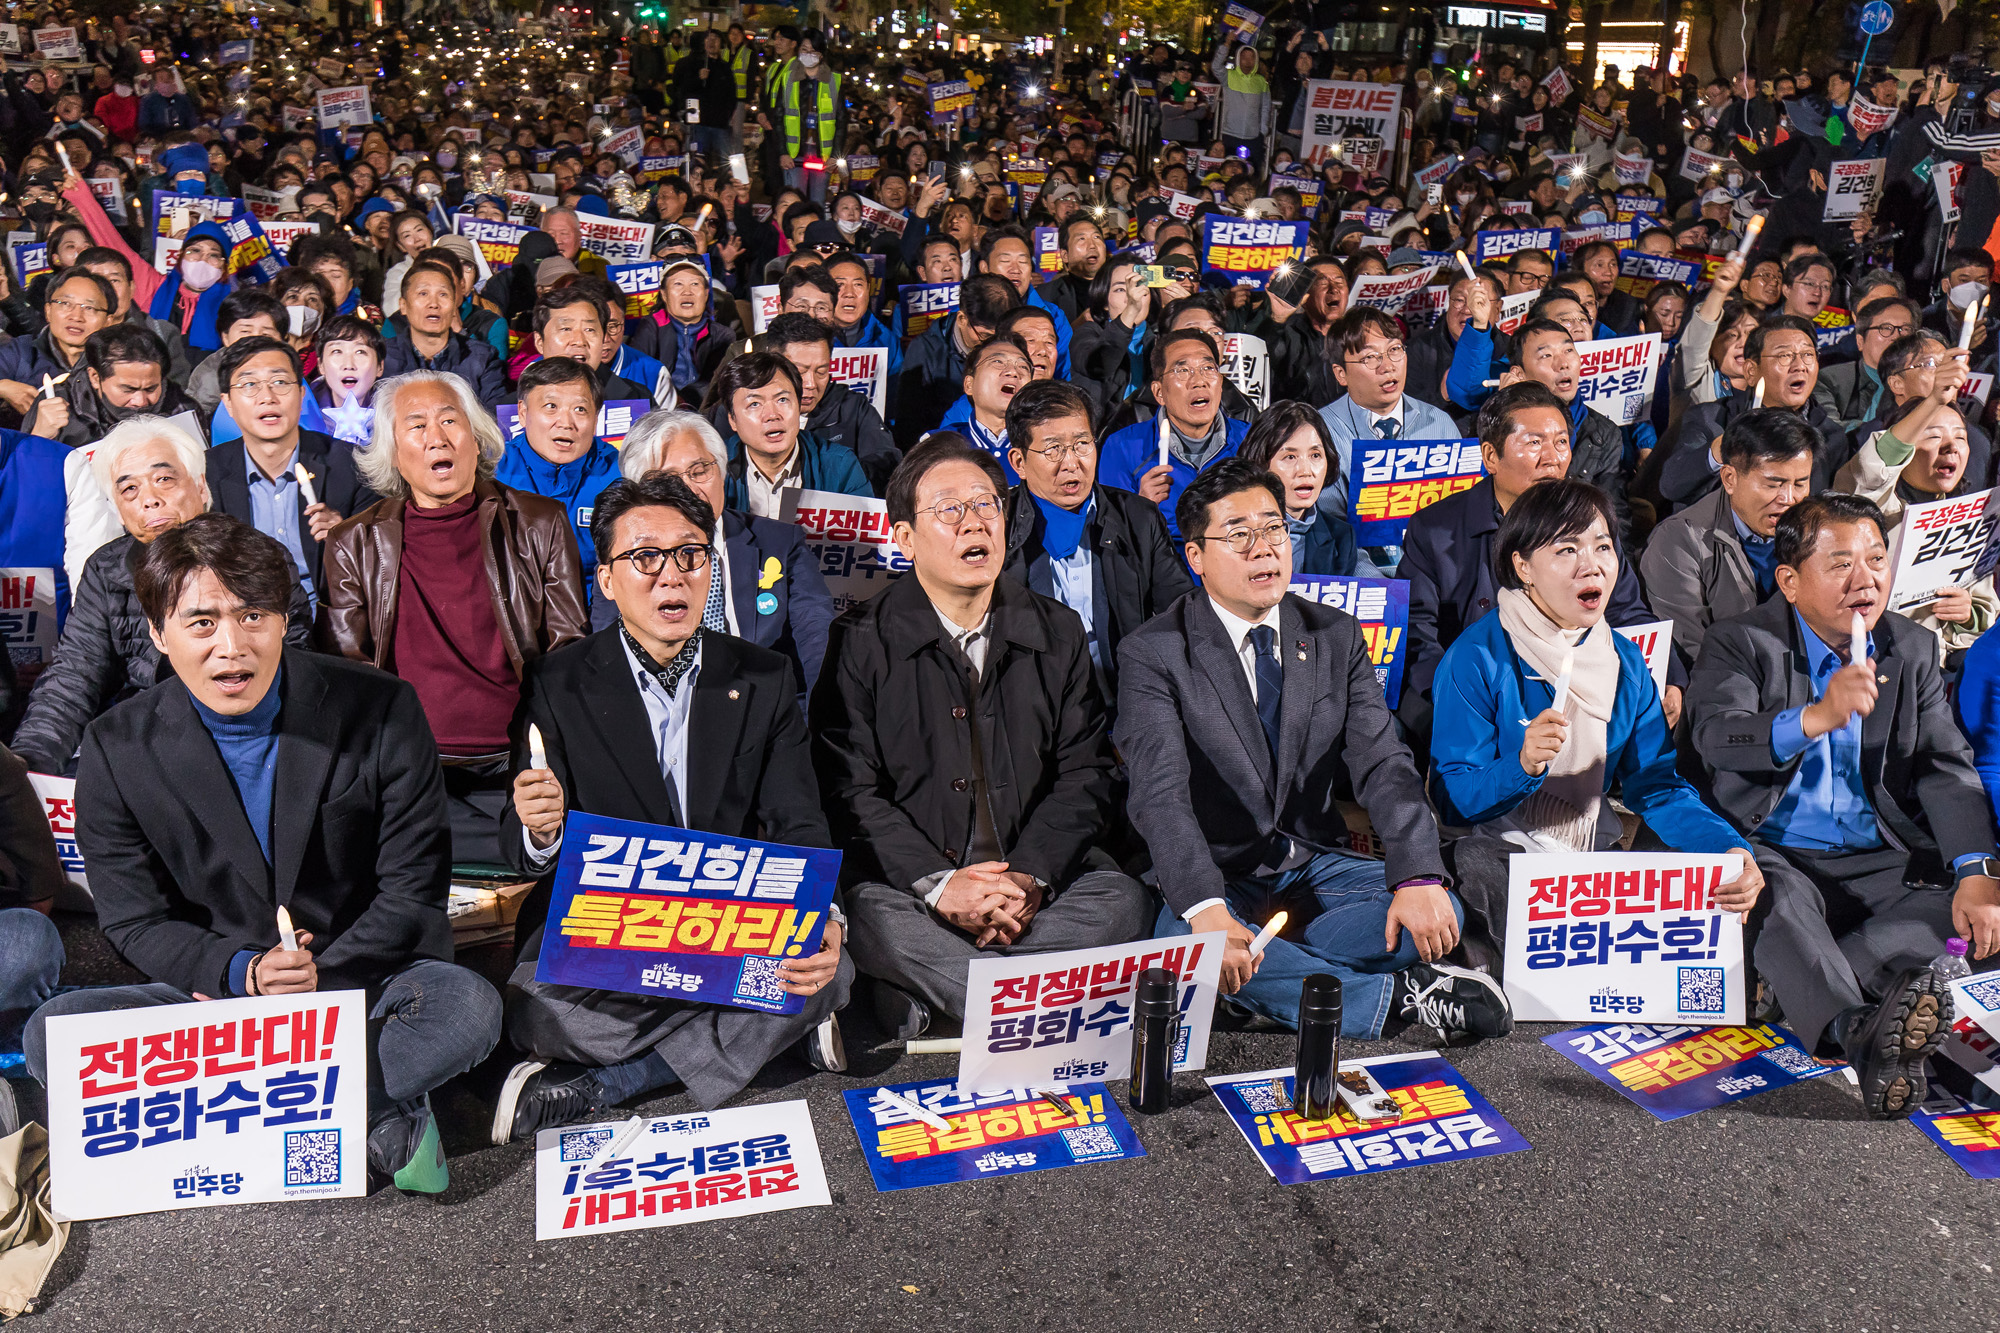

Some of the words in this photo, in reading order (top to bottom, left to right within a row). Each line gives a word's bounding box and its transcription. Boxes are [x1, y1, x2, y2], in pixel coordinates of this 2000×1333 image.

[1311, 86, 1397, 112] 불법사드
[1211, 221, 1296, 246] 김건희를
[1482, 230, 1552, 257] 김건희를
[615, 265, 664, 294] 김건
[1622, 255, 1692, 282] 김건희를
[1358, 269, 1432, 299] 전쟁반대!
[1398, 289, 1447, 313] 반대!
[1362, 442, 1483, 483] 김건희를
[795, 507, 897, 545] 전쟁반
[1913, 494, 1992, 532] 국정농단
[579, 834, 808, 900] 김건희를
[1527, 866, 1724, 922] 전쟁반대!
[560, 893, 821, 956] 특검하라!
[1525, 914, 1721, 970] 평화수호!
[641, 968, 704, 993] 민주당
[990, 942, 1205, 1016] 전쟁반대!
[732, 996, 784, 1011] sign.theminjoo.kr
[1589, 994, 1645, 1015] 민주당
[1677, 1012, 1725, 1022] sign.theminjoo.kr
[987, 984, 1198, 1054] 평화수!
[79, 1005, 341, 1099] 전쟁반대!
[1568, 1023, 1710, 1066] 김건
[1607, 1022, 1786, 1092] 특검하라!
[1053, 1060, 1108, 1081] 민주당
[1715, 1074, 1769, 1096] 민주당
[81, 1065, 341, 1159] 평화수호!
[649, 1116, 711, 1134] 민주당
[877, 1093, 1107, 1158] 특검하라!
[1296, 1113, 1502, 1175] 김건희를
[183, 1164, 211, 1177] 더불어
[562, 1133, 792, 1196] 평화수호!
[974, 1151, 1038, 1173] 민주당
[173, 1171, 244, 1199] 민주당
[284, 1185, 342, 1198] sign.theminjoo.kr
[562, 1162, 800, 1230] 전쟁반대!
